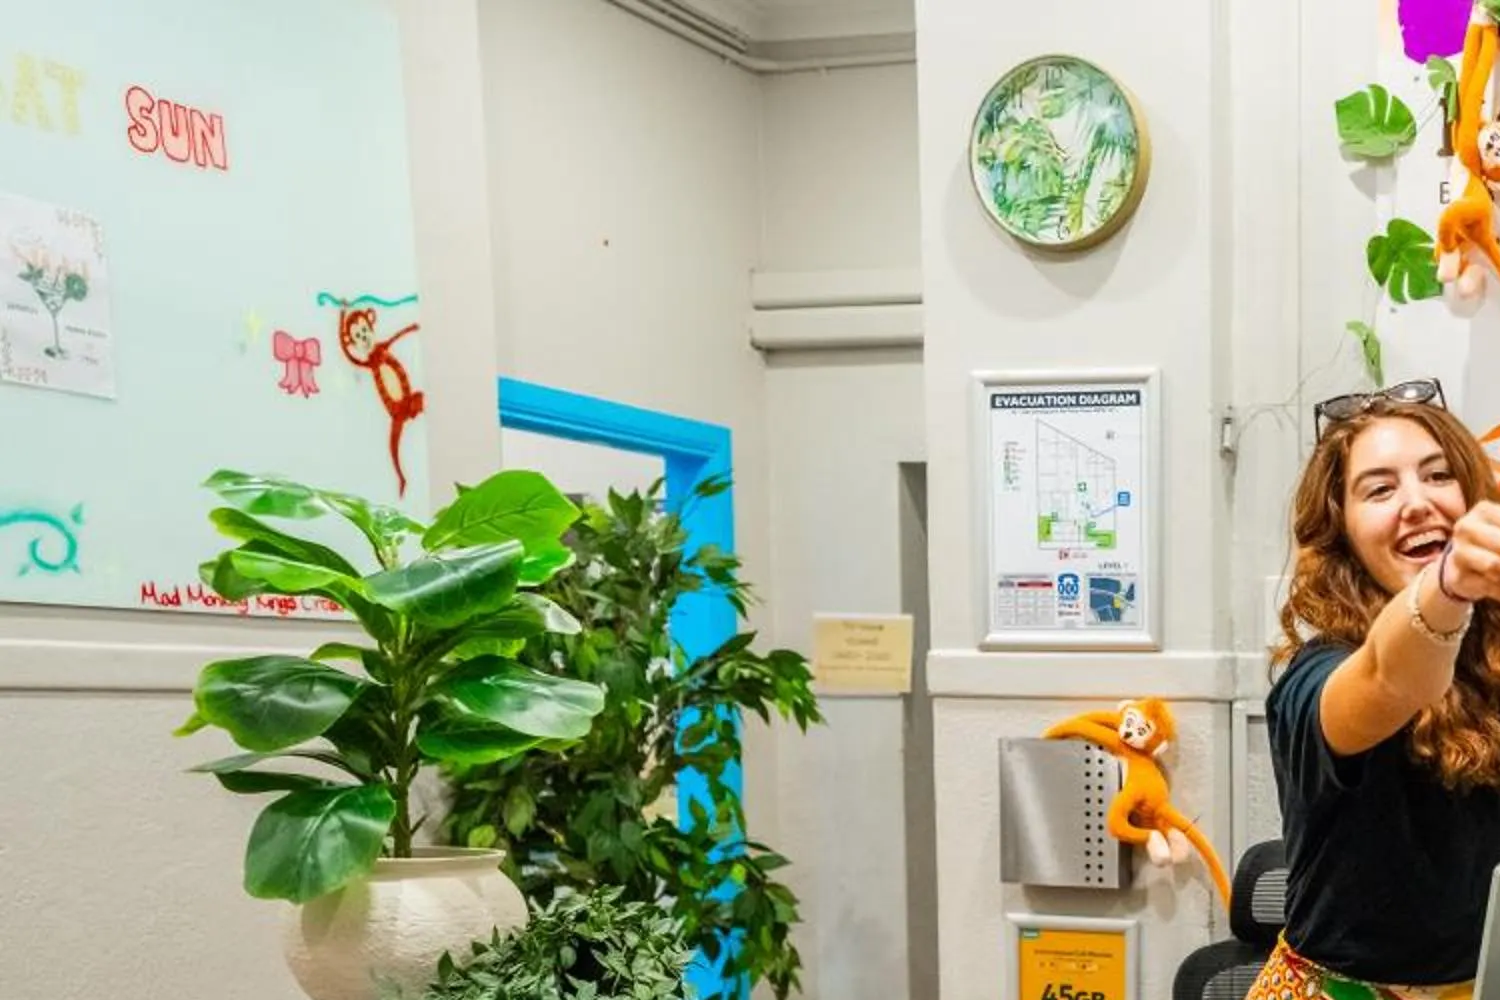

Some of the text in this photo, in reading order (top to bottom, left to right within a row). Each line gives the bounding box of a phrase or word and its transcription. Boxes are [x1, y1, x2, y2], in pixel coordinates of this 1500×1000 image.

[0, 50, 228, 170] AT SUN
[994, 393, 1137, 407] EVACUATION DIAGRAM
[141, 580, 181, 606] Mad
